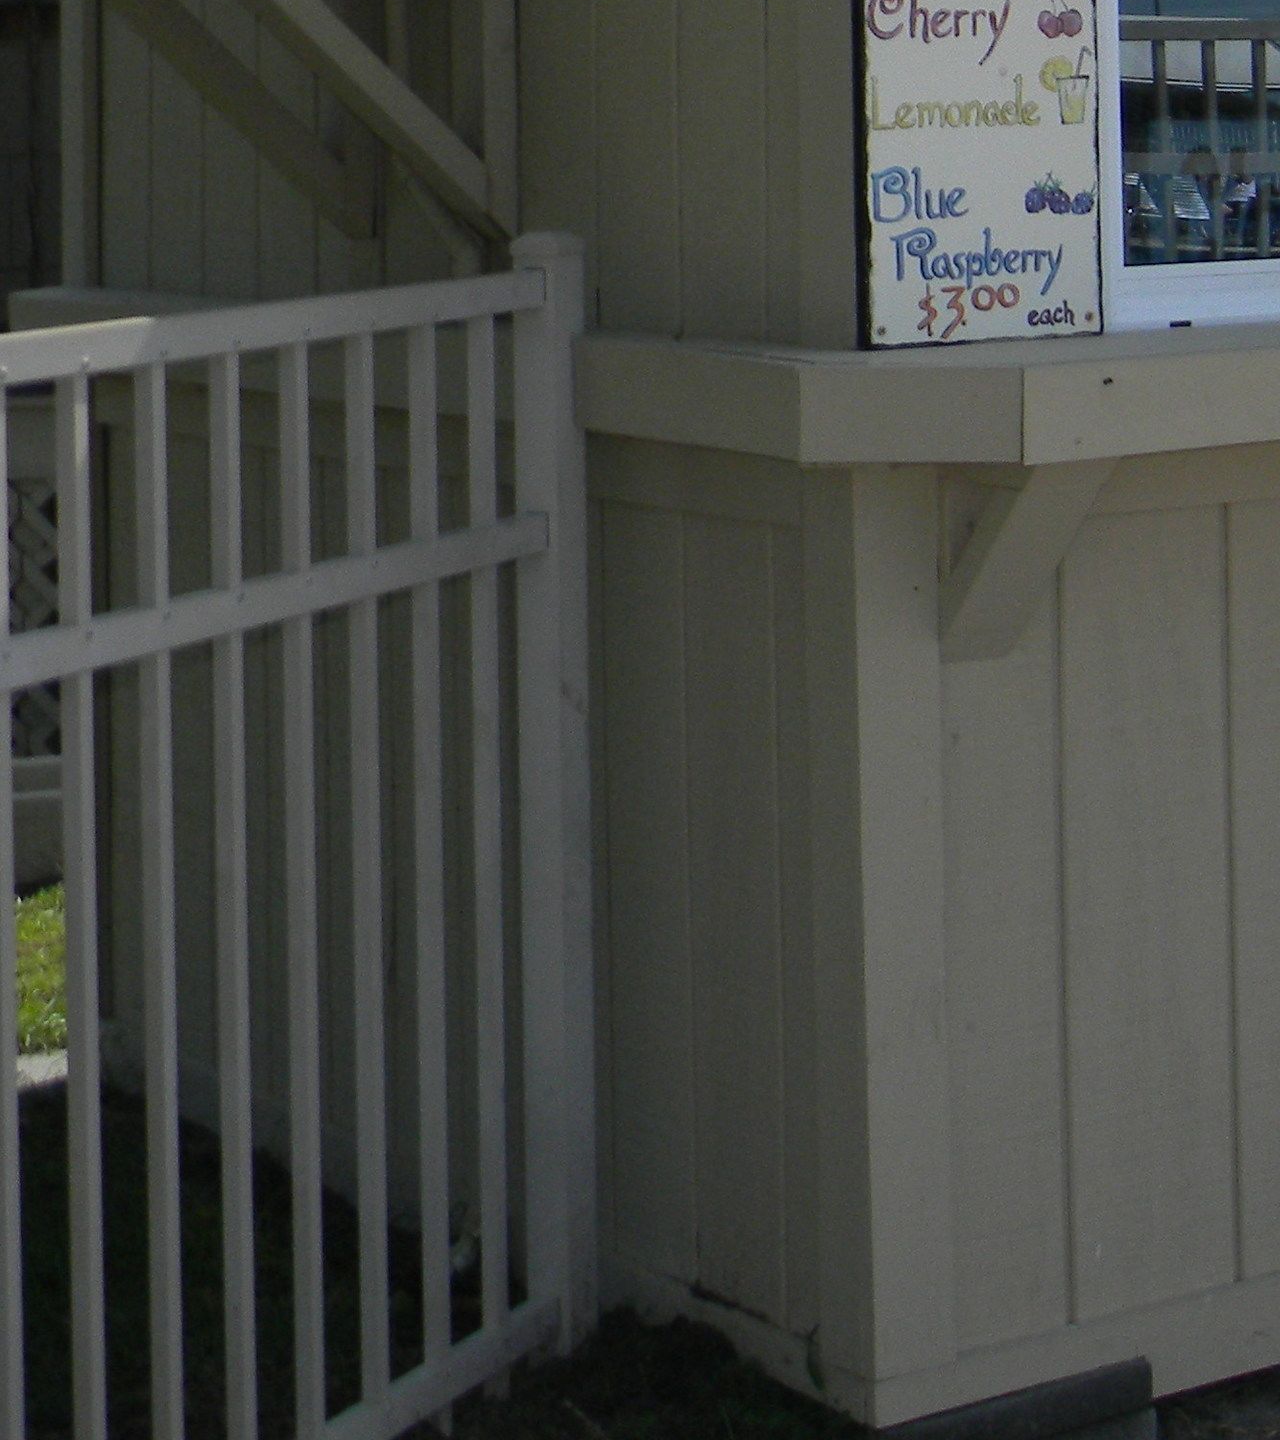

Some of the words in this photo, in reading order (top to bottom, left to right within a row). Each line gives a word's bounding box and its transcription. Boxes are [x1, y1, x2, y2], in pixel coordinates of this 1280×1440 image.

[868, 73, 1041, 131] Lemonade
[870, 166, 969, 224] Blue
[889, 226, 1063, 296] Raspberry
[1027, 299, 1076, 326] each
